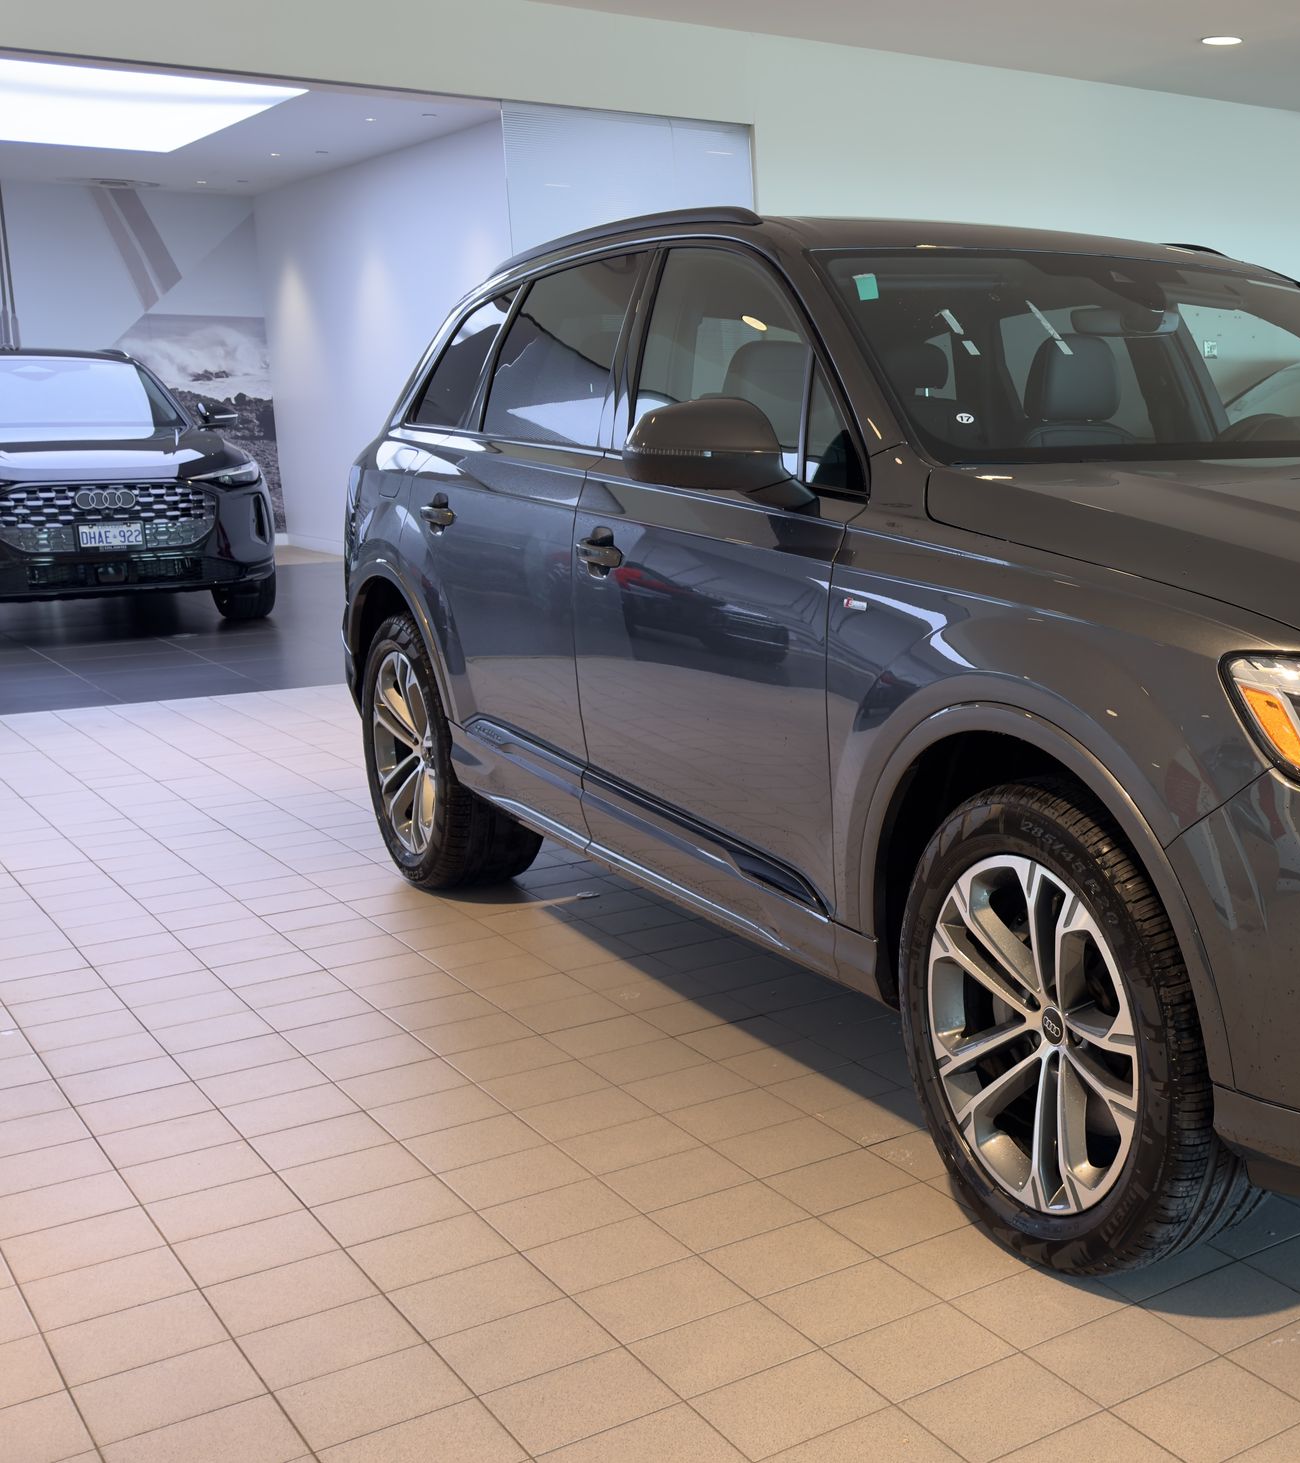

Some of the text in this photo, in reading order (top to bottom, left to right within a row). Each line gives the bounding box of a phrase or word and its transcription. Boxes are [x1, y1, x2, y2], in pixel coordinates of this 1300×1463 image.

[80, 529, 142, 545] DHAE 922
[1020, 821, 1086, 873] 285/45
